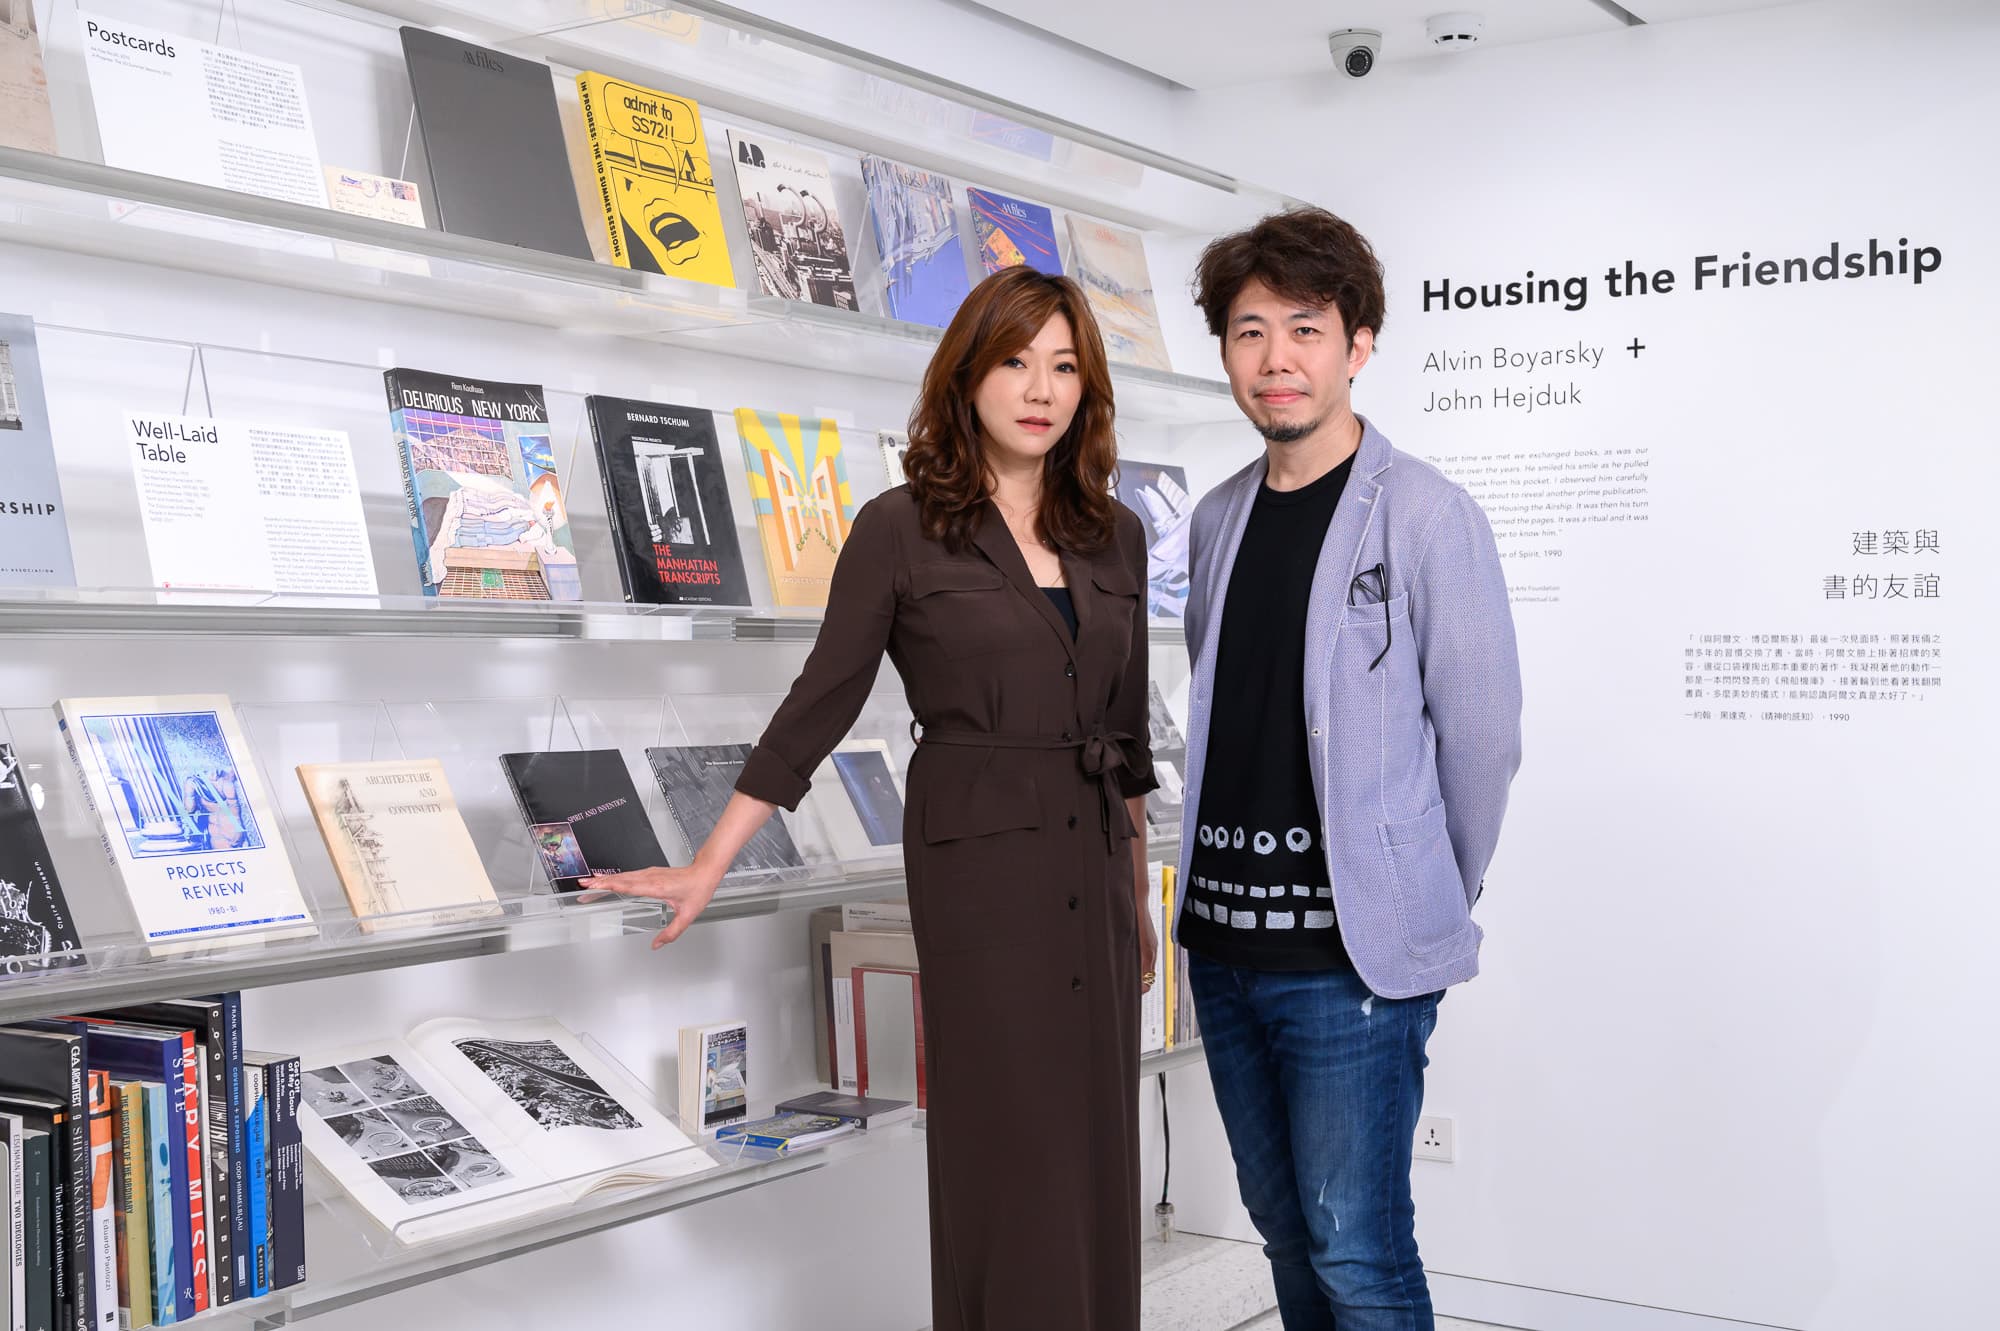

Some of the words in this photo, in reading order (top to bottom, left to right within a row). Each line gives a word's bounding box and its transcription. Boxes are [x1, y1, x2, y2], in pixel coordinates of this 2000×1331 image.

[87, 20, 176, 58] Postcards
[580, 80, 587, 90] IN
[582, 91, 598, 141] PROGRESS:
[623, 94, 659, 118] admit
[660, 103, 673, 122] to
[632, 116, 676, 141] SS72!!
[592, 142, 602, 160] THE
[599, 176, 613, 214] SUMMER
[606, 215, 622, 258] SESSIONS
[1422, 270, 1589, 312] Housing
[1604, 260, 1676, 299] the
[1694, 237, 1943, 292] Friendship
[1423, 348, 1482, 373] Alvin
[1493, 339, 1605, 374] Boyarsky
[1626, 337, 1646, 359] +
[450, 382, 462, 393] Rem
[462, 383, 484, 395] Koolhaas
[1423, 388, 1482, 413] John
[1493, 382, 1583, 413] Hejduk
[402, 388, 463, 415] DELIRIOUS
[472, 394, 501, 419] NEW
[504, 397, 541, 422] YORK
[132, 418, 218, 444] Well-Laid
[626, 412, 659, 424] BERNARD
[660, 416, 690, 428] TSCHUMI
[136, 442, 187, 464] Table
[397, 441, 411, 482] DELIRIOUS
[1529, 450, 1570, 459] exchanged
[1538, 463, 1563, 471] smiled
[1624, 460, 1649, 470] pulled
[404, 479, 413, 498] NEW
[1468, 479, 1486, 487] book
[1523, 477, 1550, 487] pocket.
[1560, 475, 1596, 483] observed
[1616, 473, 1648, 482] carefully
[1521, 490, 1544, 498] reveal
[1546, 489, 1575, 497] another
[1578, 489, 1600, 498] prime
[408, 498, 418, 520] YORK
[1499, 504, 1529, 513] Housing
[1545, 503, 1573, 511] Airship.
[1620, 500, 1630, 508] his
[1517, 517, 1529, 525] the
[1531, 517, 1555, 526] pages.
[1588, 514, 1608, 522] ritual
[1610, 514, 1625, 522] and
[652, 543, 672, 557] THE
[1509, 550, 1516, 558] of
[1544, 549, 1562, 557] 1990
[1852, 528, 1940, 556] 建築與
[656, 557, 718, 572] MANHATTAN
[658, 571, 721, 585] TRANSCRIPTS
[1822, 572, 1941, 600] 書的友誼
[364, 772, 433, 785] ARCHITECTURE
[418, 787, 437, 798] AND
[388, 803, 443, 816] CONTINUITY
[567, 813, 585, 824] SPIRIT
[584, 808, 598, 818] AND
[598, 797, 627, 813] INVENTION
[166, 861, 247, 880] PROJECTS
[182, 881, 245, 901] REVIEW
[51, 903, 64, 930] Claire
[230, 1005, 238, 1028] FRANK
[211, 1010, 223, 1082] COOP
[231, 1029, 239, 1061] WERNER
[71, 1068, 82, 1107] ARCHITECT
[172, 1057, 187, 1113] SITE
[232, 1067, 240, 1106] COVERING
[121, 1094, 129, 1108] THE
[182, 1047, 200, 1151] MARY
[121, 1109, 131, 1145] DISCOVERY
[234, 1115, 242, 1153] EXPOSING
[72, 1127, 83, 1162] SHIN
[123, 1150, 131, 1160] OF
[123, 1163, 132, 1177] THE
[235, 1161, 243, 1180] COOP
[55, 1184, 63, 1203] The
[124, 1178, 134, 1214] ORDINARY
[14, 1199, 22, 1219] TWO
[55, 1205, 64, 1224] End
[73, 1167, 85, 1253] TAKAMATSU
[56, 1225, 64, 1235] of
[102, 1218, 111, 1254] Eduardo
[189, 1179, 206, 1277] MISS
[15, 1221, 23, 1267] IDEOLOGIES
[55, 1236, 65, 1298] Architecture?
[103, 1256, 112, 1291] Paolozzi
